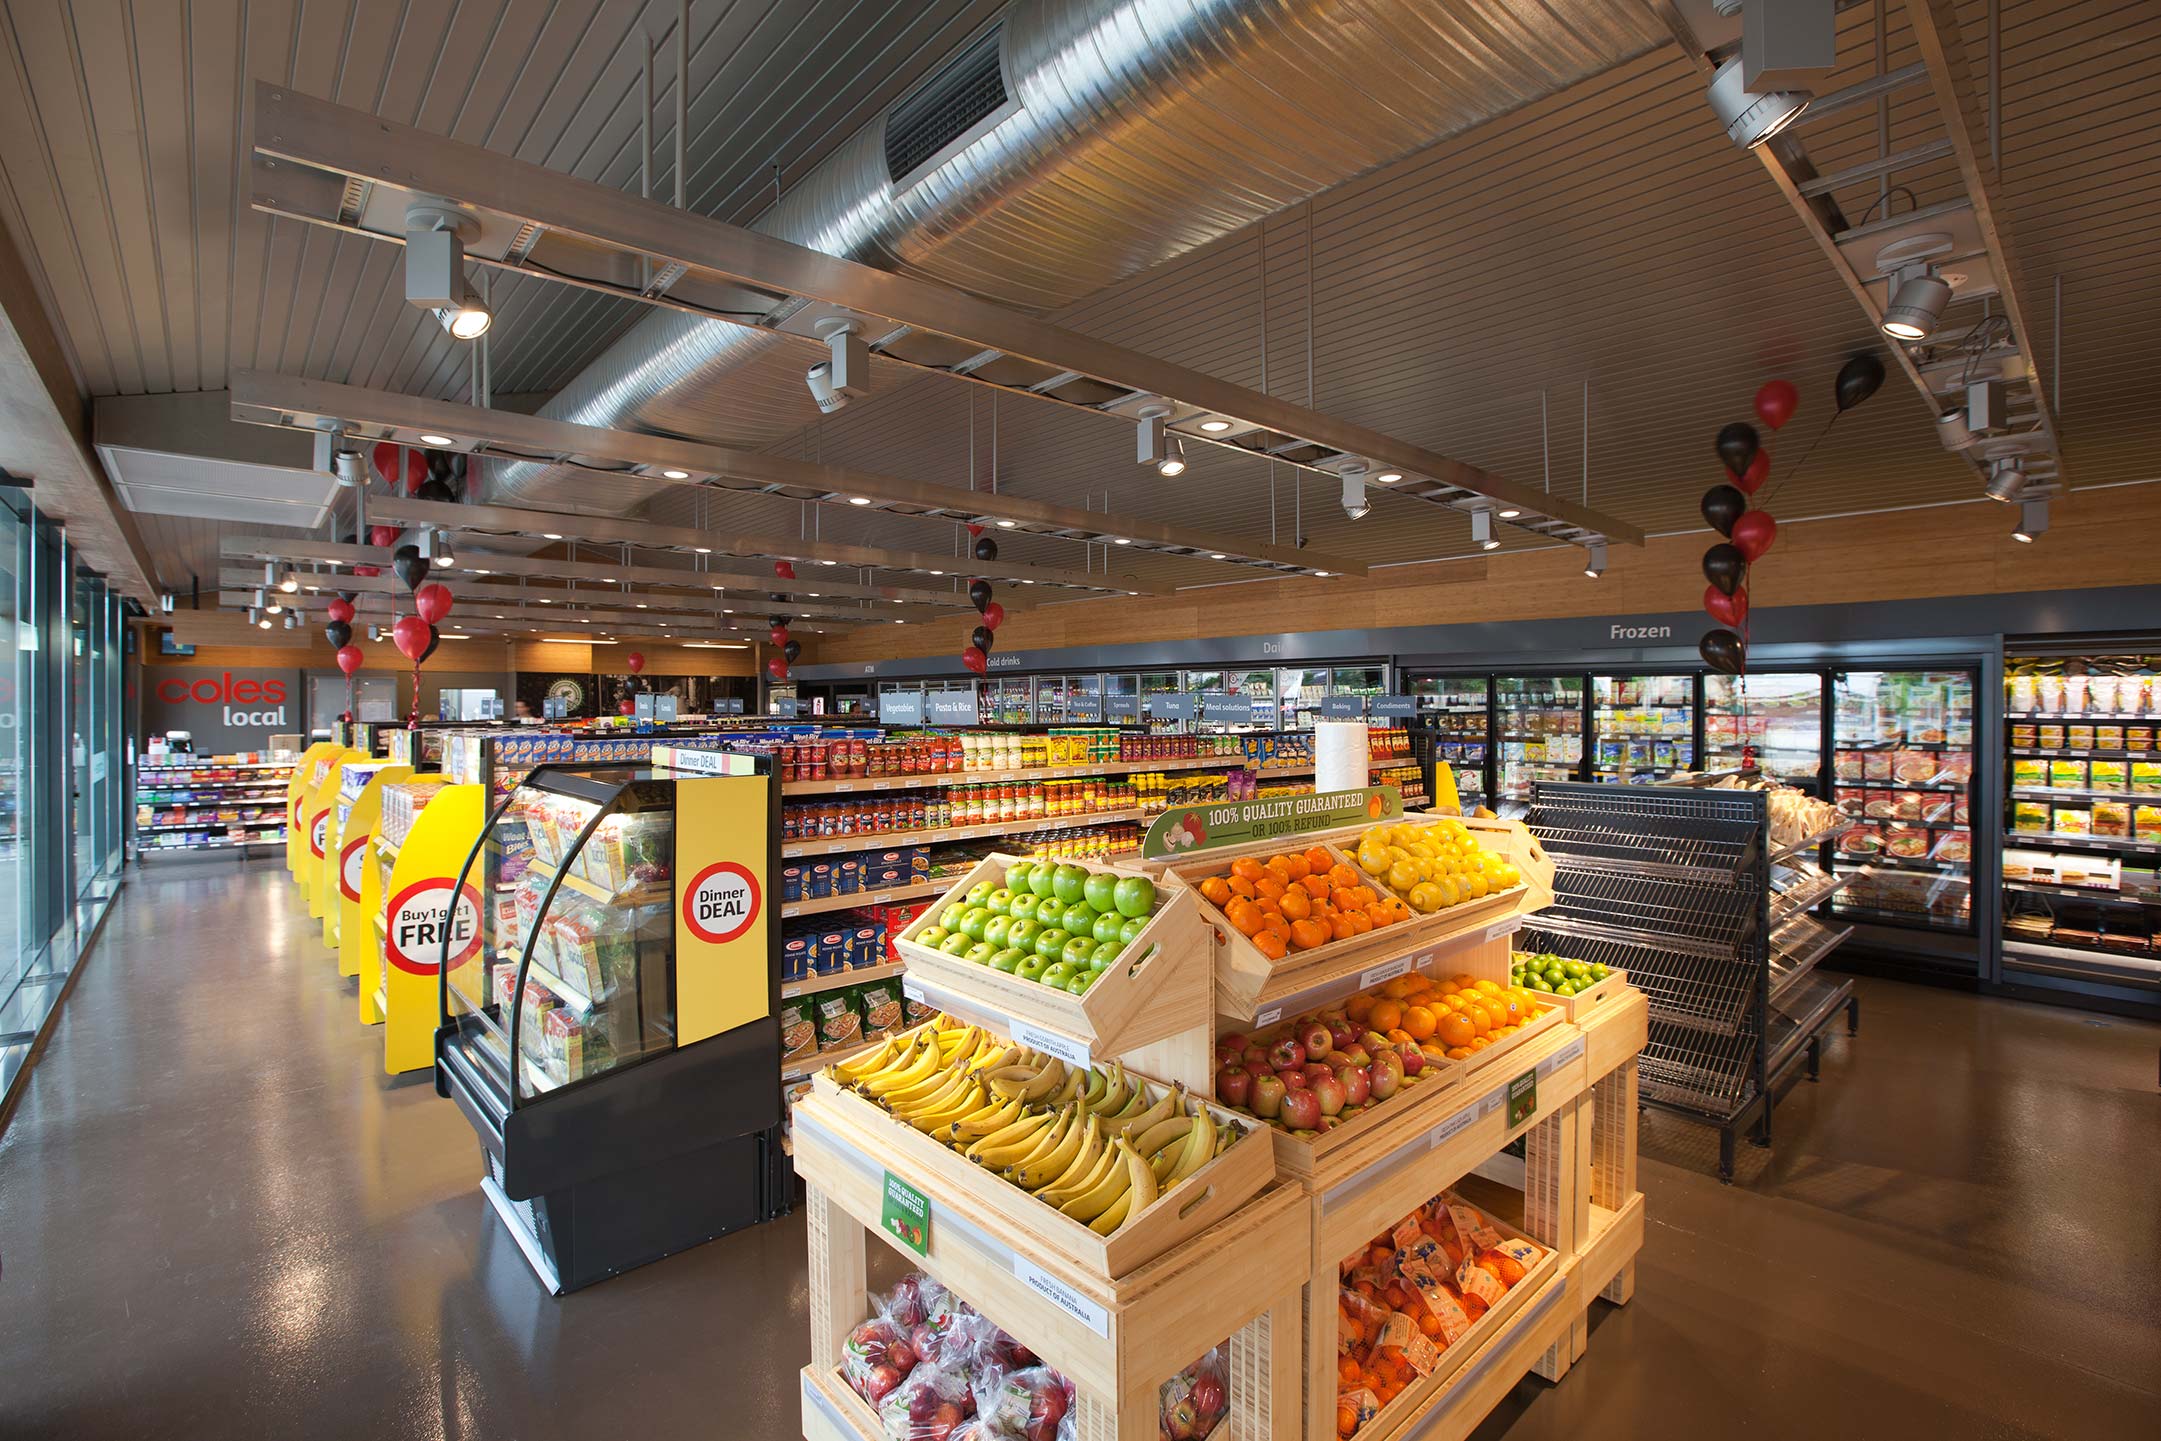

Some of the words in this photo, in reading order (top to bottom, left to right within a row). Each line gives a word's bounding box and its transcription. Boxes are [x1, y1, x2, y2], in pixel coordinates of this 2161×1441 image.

[1610, 624, 1671, 639] Frozen
[986, 656, 1000, 667] Cold
[1000, 655, 1021, 666] drinks
[157, 672, 287, 705] coles
[223, 705, 287, 727] local
[885, 703, 915, 714] Vegetables
[935, 702, 952, 712] Pasta
[958, 702, 972, 712] Rice
[1205, 703, 1221, 711] Meal
[1222, 704, 1250, 712] solutions
[1332, 703, 1351, 711] Baking
[1376, 702, 1411, 710] Condiments
[680, 750, 700, 767] Dinner
[700, 752, 717, 769] DEAL
[1209, 807, 1239, 826] 100%
[1242, 801, 1294, 823] QUALITY
[1296, 793, 1364, 815] GUARANTEED
[1252, 824, 1266, 838] OR
[1268, 820, 1292, 835] 100%
[1294, 815, 1331, 832] REFUND
[698, 886, 746, 902] Dinner
[439, 906, 462, 920] gt
[698, 900, 746, 921] DEAL
[1022, 1035, 1043, 1048] PRODUCT
[1050, 1046, 1076, 1060] AUSTRALIA
[888, 1187, 924, 1217] GUARANTEED
[901, 1187, 924, 1209] QUALITY
[1028, 1275, 1052, 1296] PRODUCT
[1052, 1292, 1060, 1301] OF
[1060, 1297, 1091, 1322] AUSTRALIA
[1040, 1275, 1056, 1291] FRESH
[1056, 1286, 1078, 1305] BANANA
